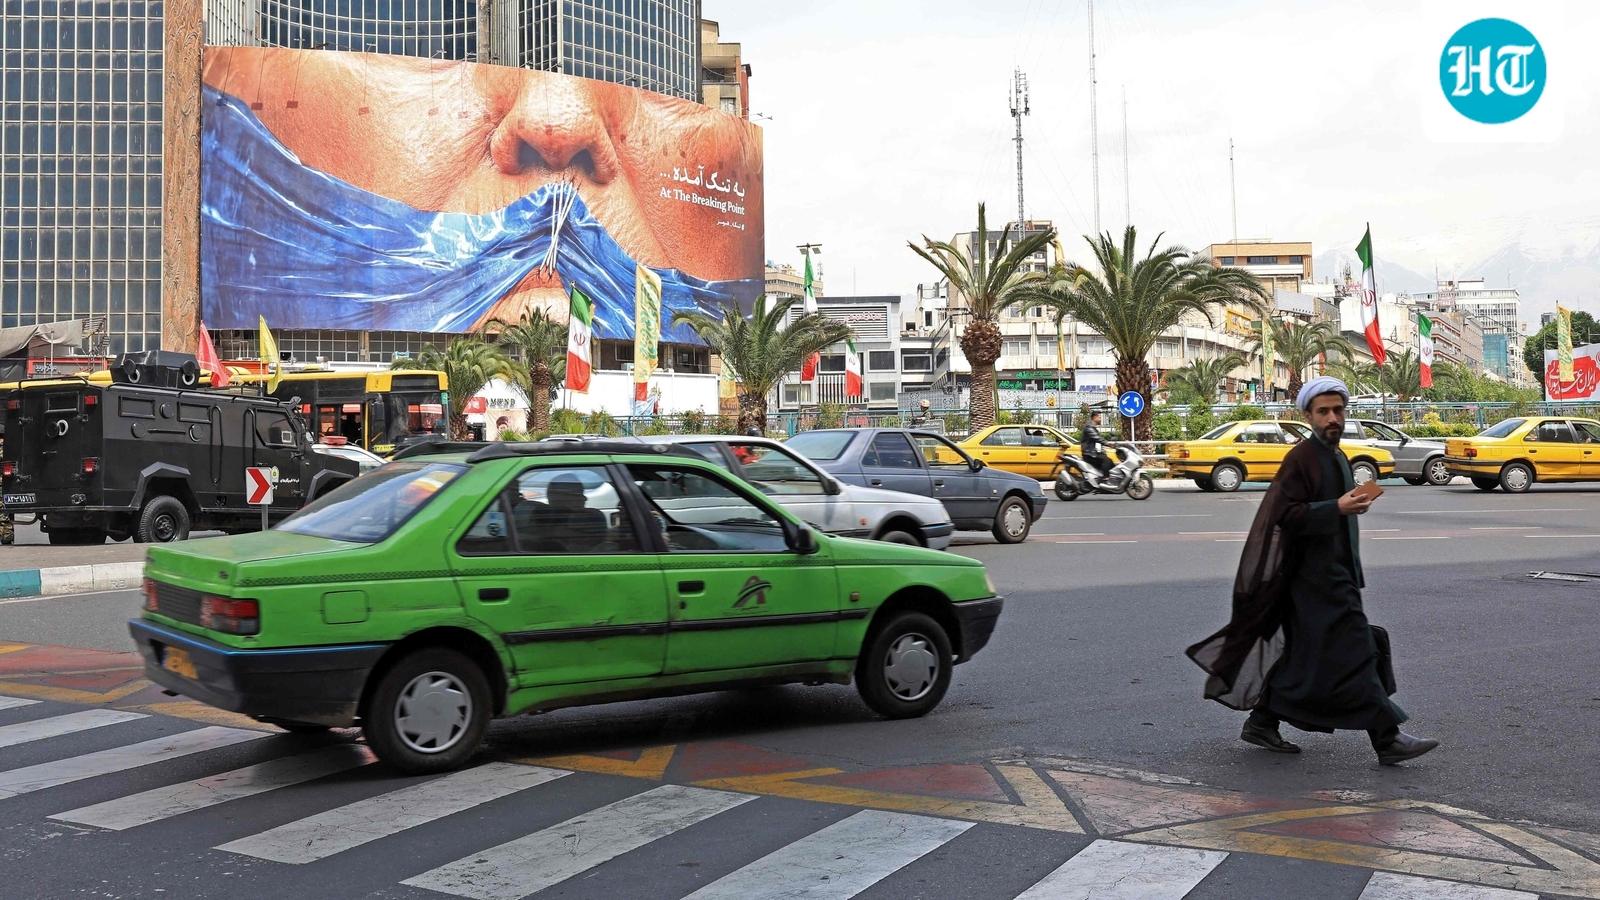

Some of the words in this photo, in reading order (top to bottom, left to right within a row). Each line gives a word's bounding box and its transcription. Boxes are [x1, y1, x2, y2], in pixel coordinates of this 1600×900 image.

[705, 171, 731, 193] تنگ
[733, 181, 745, 201] به
[660, 187, 671, 198] At
[673, 188, 690, 202] The
[692, 193, 726, 213] Breaking
[728, 201, 745, 215] Point
